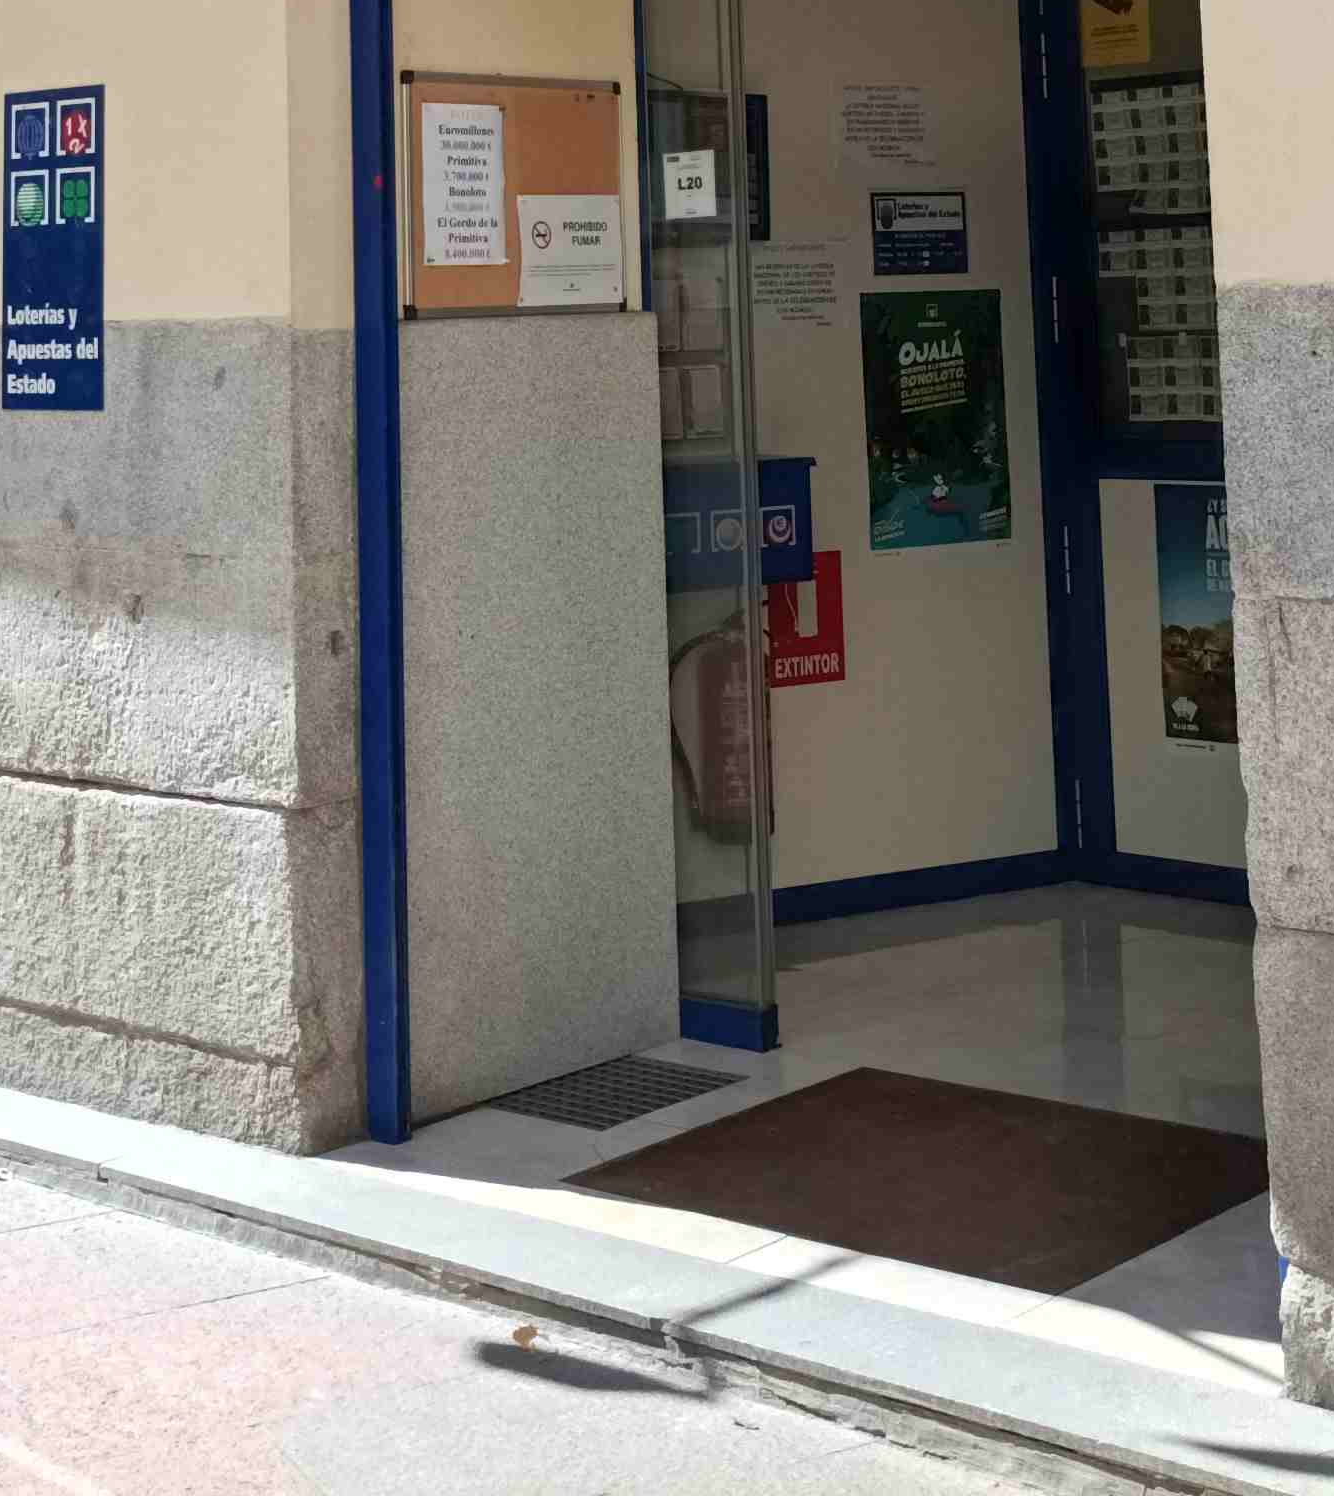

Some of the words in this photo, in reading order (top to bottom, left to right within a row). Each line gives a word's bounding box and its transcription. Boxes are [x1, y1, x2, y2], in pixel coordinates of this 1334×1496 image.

[447, 155, 487, 167] Primitiva
[677, 176, 703, 190] L20
[563, 221, 607, 233] PROHIBIDO
[448, 232, 488, 244] Primitiva
[571, 235, 601, 247] FUMAR
[7, 303, 64, 326] Loterías
[68, 305, 77, 330] y
[7, 338, 72, 365] Apuestas
[77, 336, 99, 360] del
[899, 329, 964, 366] OJALÁ
[7, 372, 56, 395] Estado
[775, 652, 840, 679] EXTINTOR
